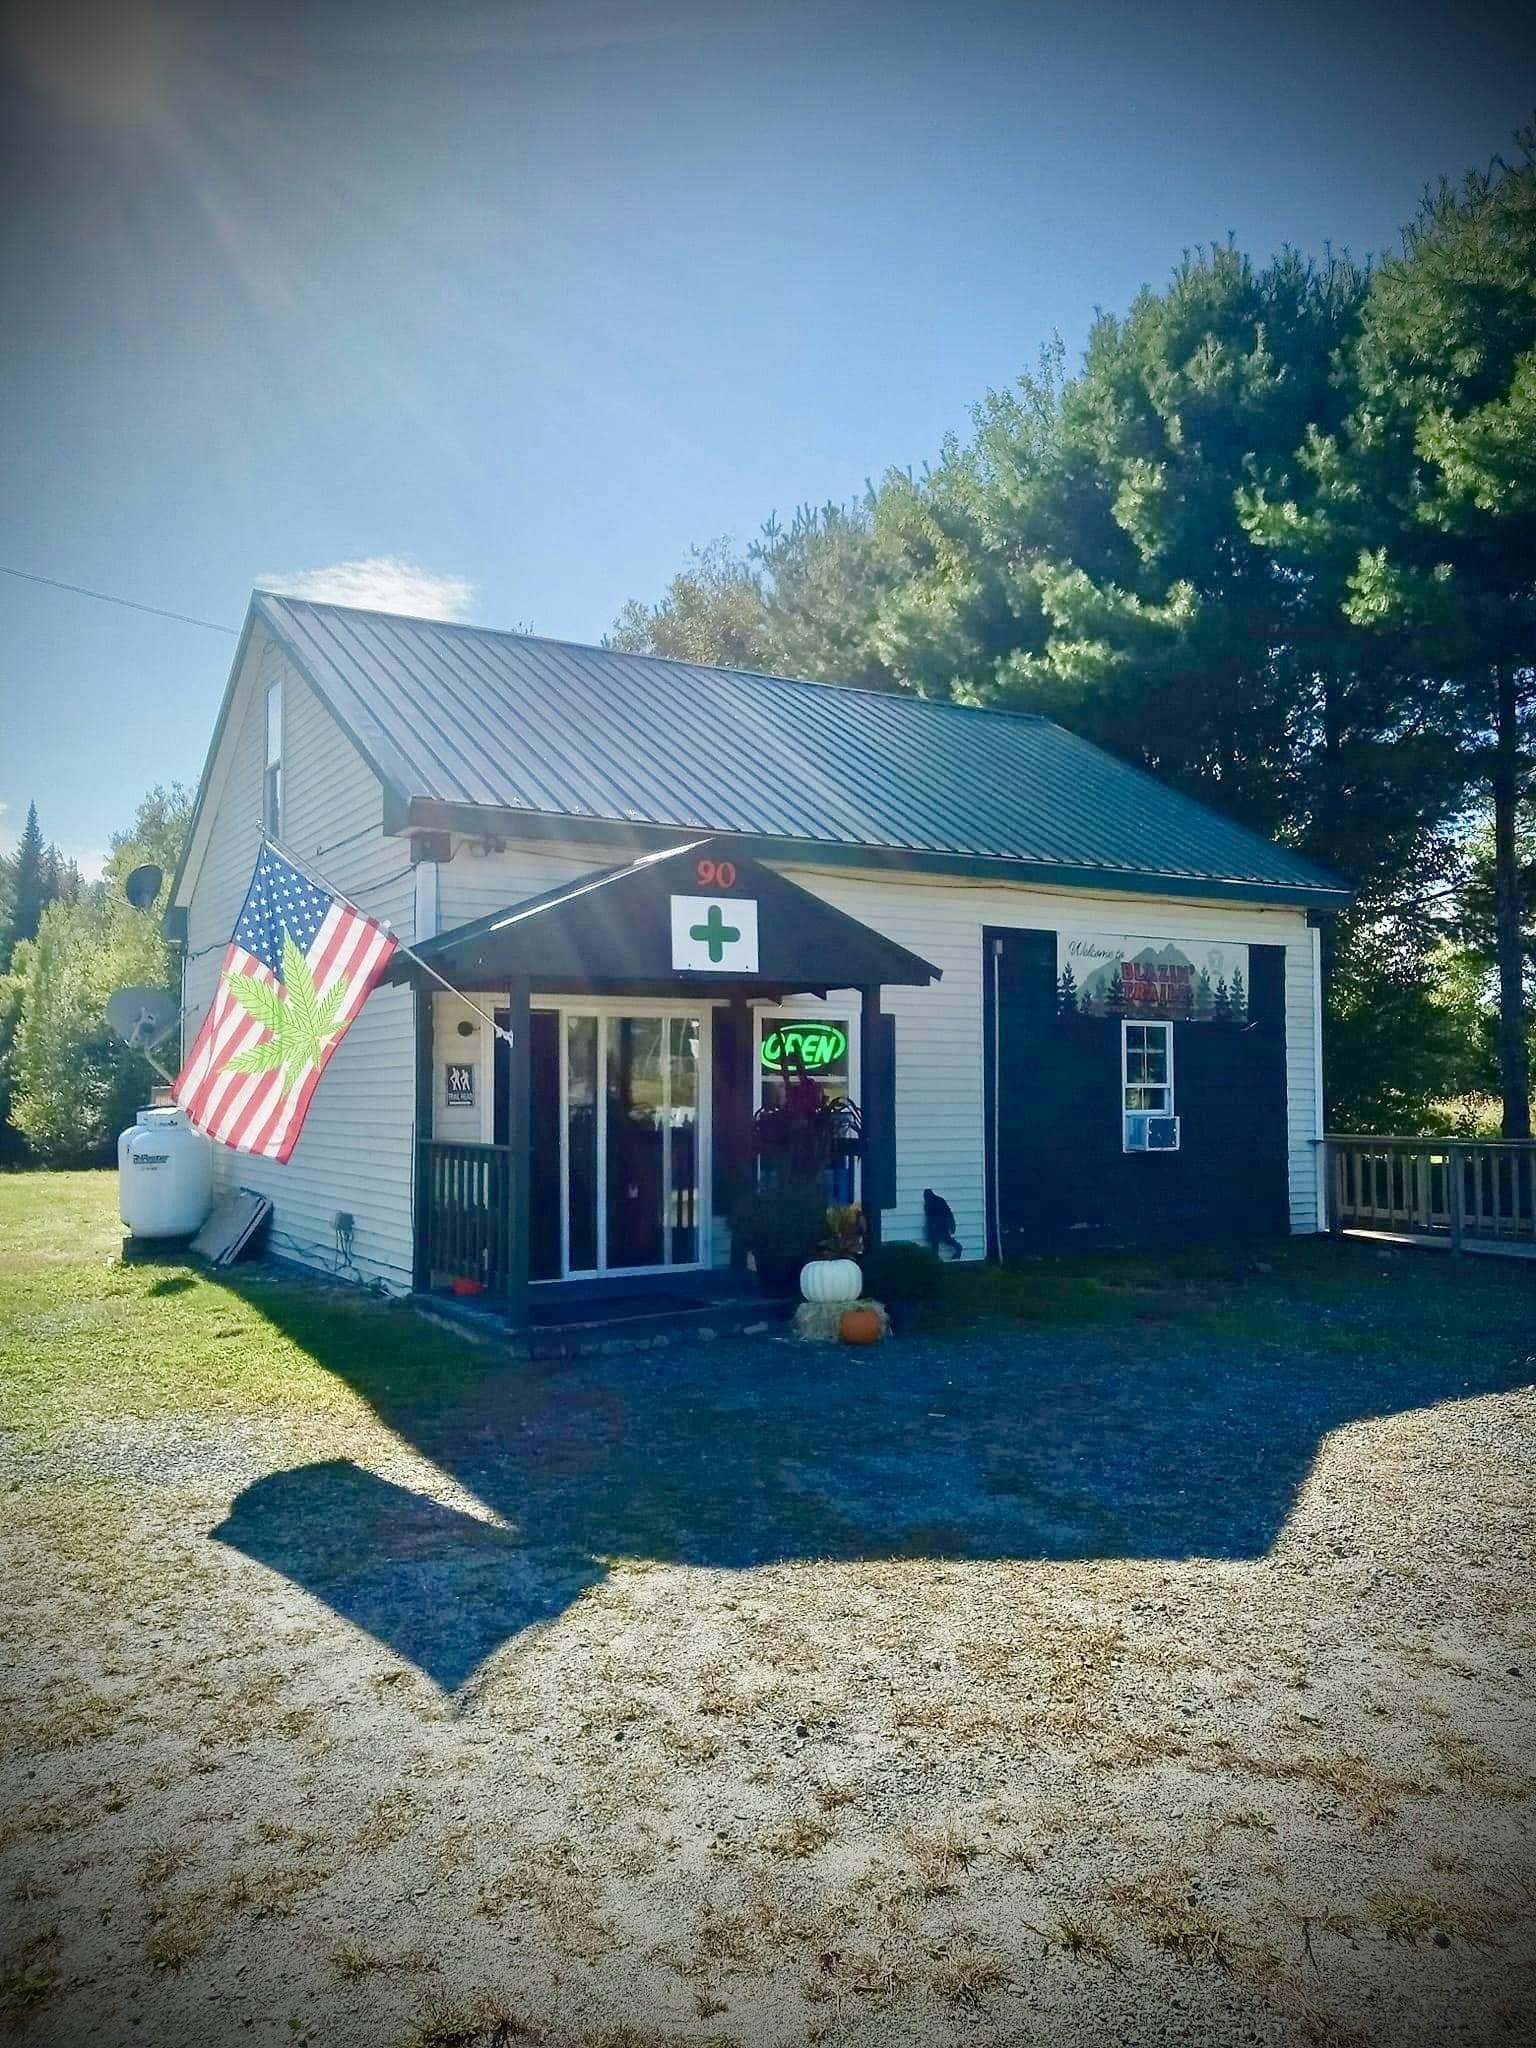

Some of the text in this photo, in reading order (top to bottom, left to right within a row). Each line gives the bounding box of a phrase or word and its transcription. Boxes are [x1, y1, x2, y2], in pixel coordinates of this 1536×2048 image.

[697, 860, 736, 888] 90
[1068, 940, 1113, 959] Welcome
[764, 1033, 837, 1063] OPEN
